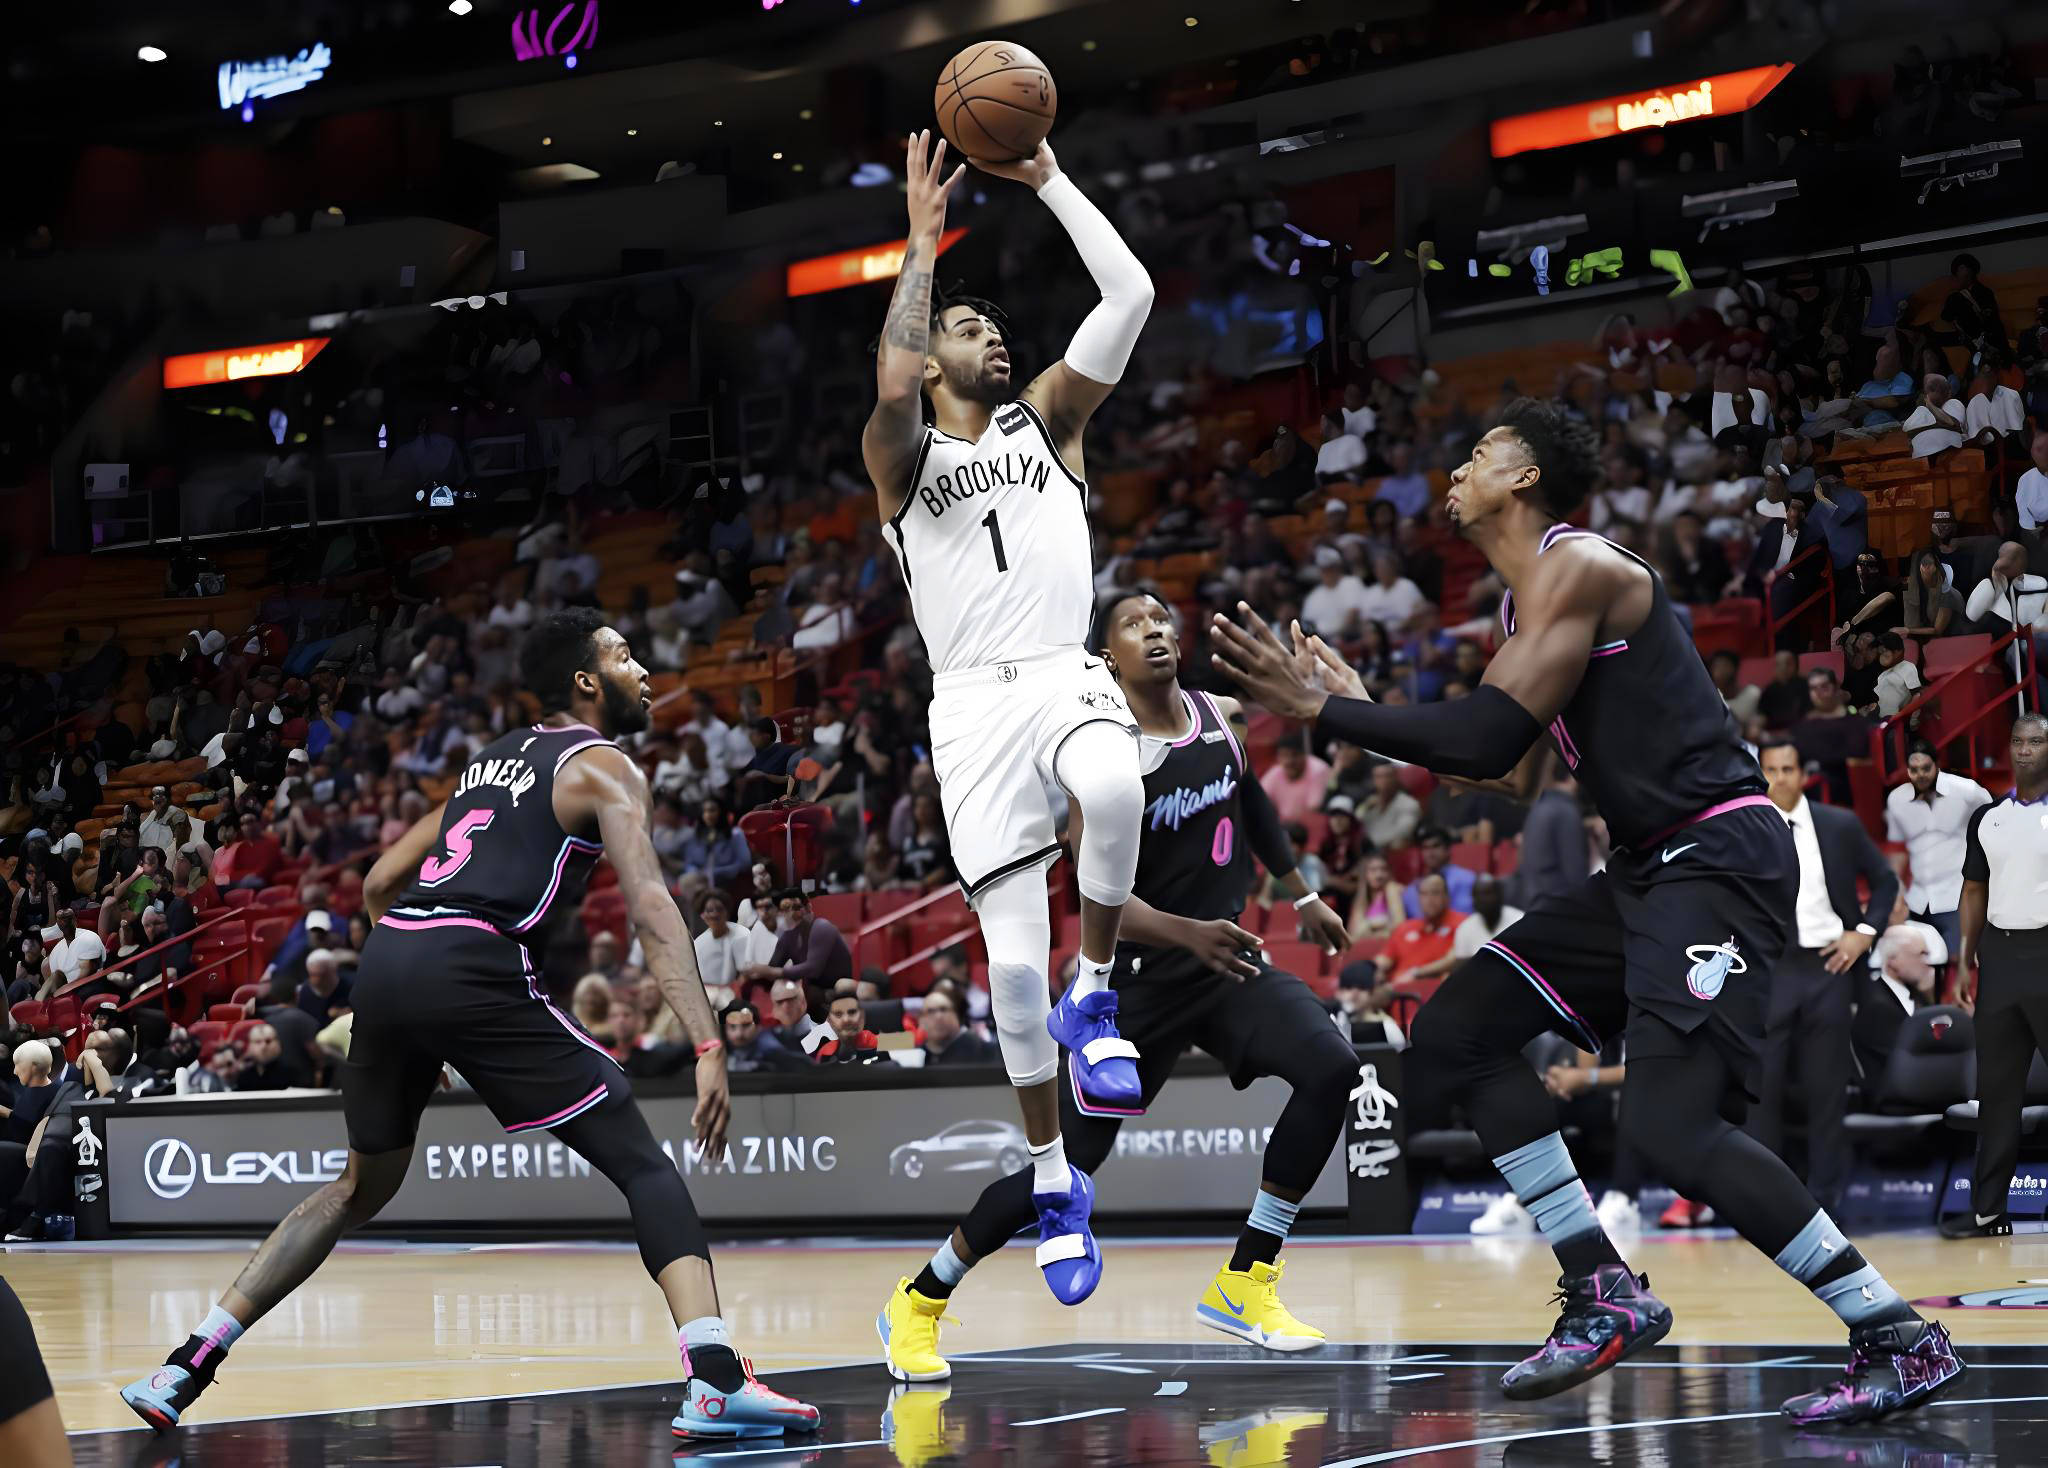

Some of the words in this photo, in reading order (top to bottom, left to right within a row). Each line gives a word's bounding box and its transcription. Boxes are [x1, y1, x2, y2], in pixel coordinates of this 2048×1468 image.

[919, 453, 1051, 518] BROOKLYN
[981, 508, 1009, 573] 1
[454, 758, 524, 799] JONES
[1144, 764, 1237, 831] Miami
[419, 808, 495, 888] 5
[1211, 816, 1234, 867] 0
[201, 1150, 349, 1184] LEXUS
[426, 1141, 591, 1179] EXPERIEN
